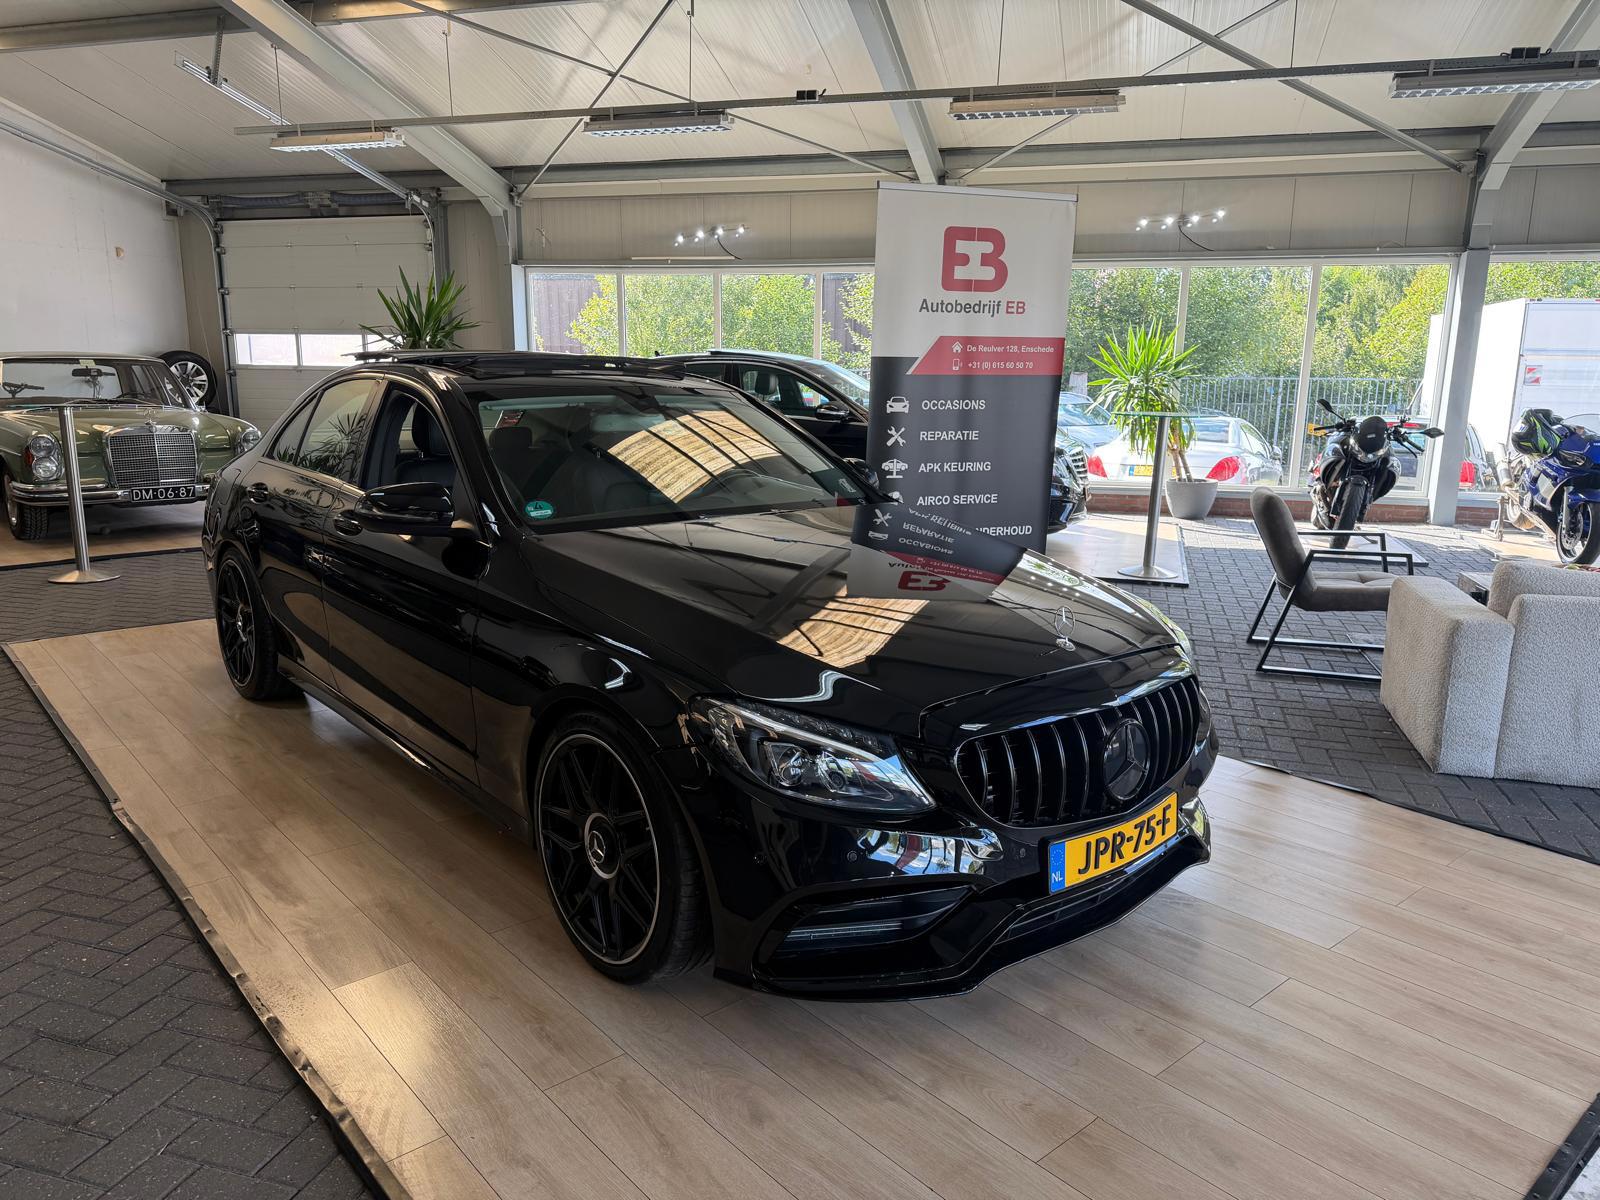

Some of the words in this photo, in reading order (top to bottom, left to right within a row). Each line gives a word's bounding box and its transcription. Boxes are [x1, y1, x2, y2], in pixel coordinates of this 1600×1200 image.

[919, 298, 1002, 318] Autobedrijf
[1005, 300, 1026, 315] EB
[966, 344, 977, 352] De
[1006, 345, 1020, 354] 128,
[1021, 345, 1055, 353] Enschede
[968, 361, 980, 369] +31
[982, 361, 991, 370] (0)
[992, 361, 1005, 369] 615
[1016, 361, 1024, 369] 50
[1025, 361, 1034, 369] 70
[921, 399, 986, 410] OCCASIONS
[919, 430, 980, 441] REPARATIE
[918, 462, 942, 473] APK
[943, 461, 992, 472] KEURING
[916, 495, 951, 506] AIRCO
[952, 493, 999, 505] SERVICE
[1051, 871, 1064, 884] NL
[1077, 803, 1172, 875] JPR-75-F
